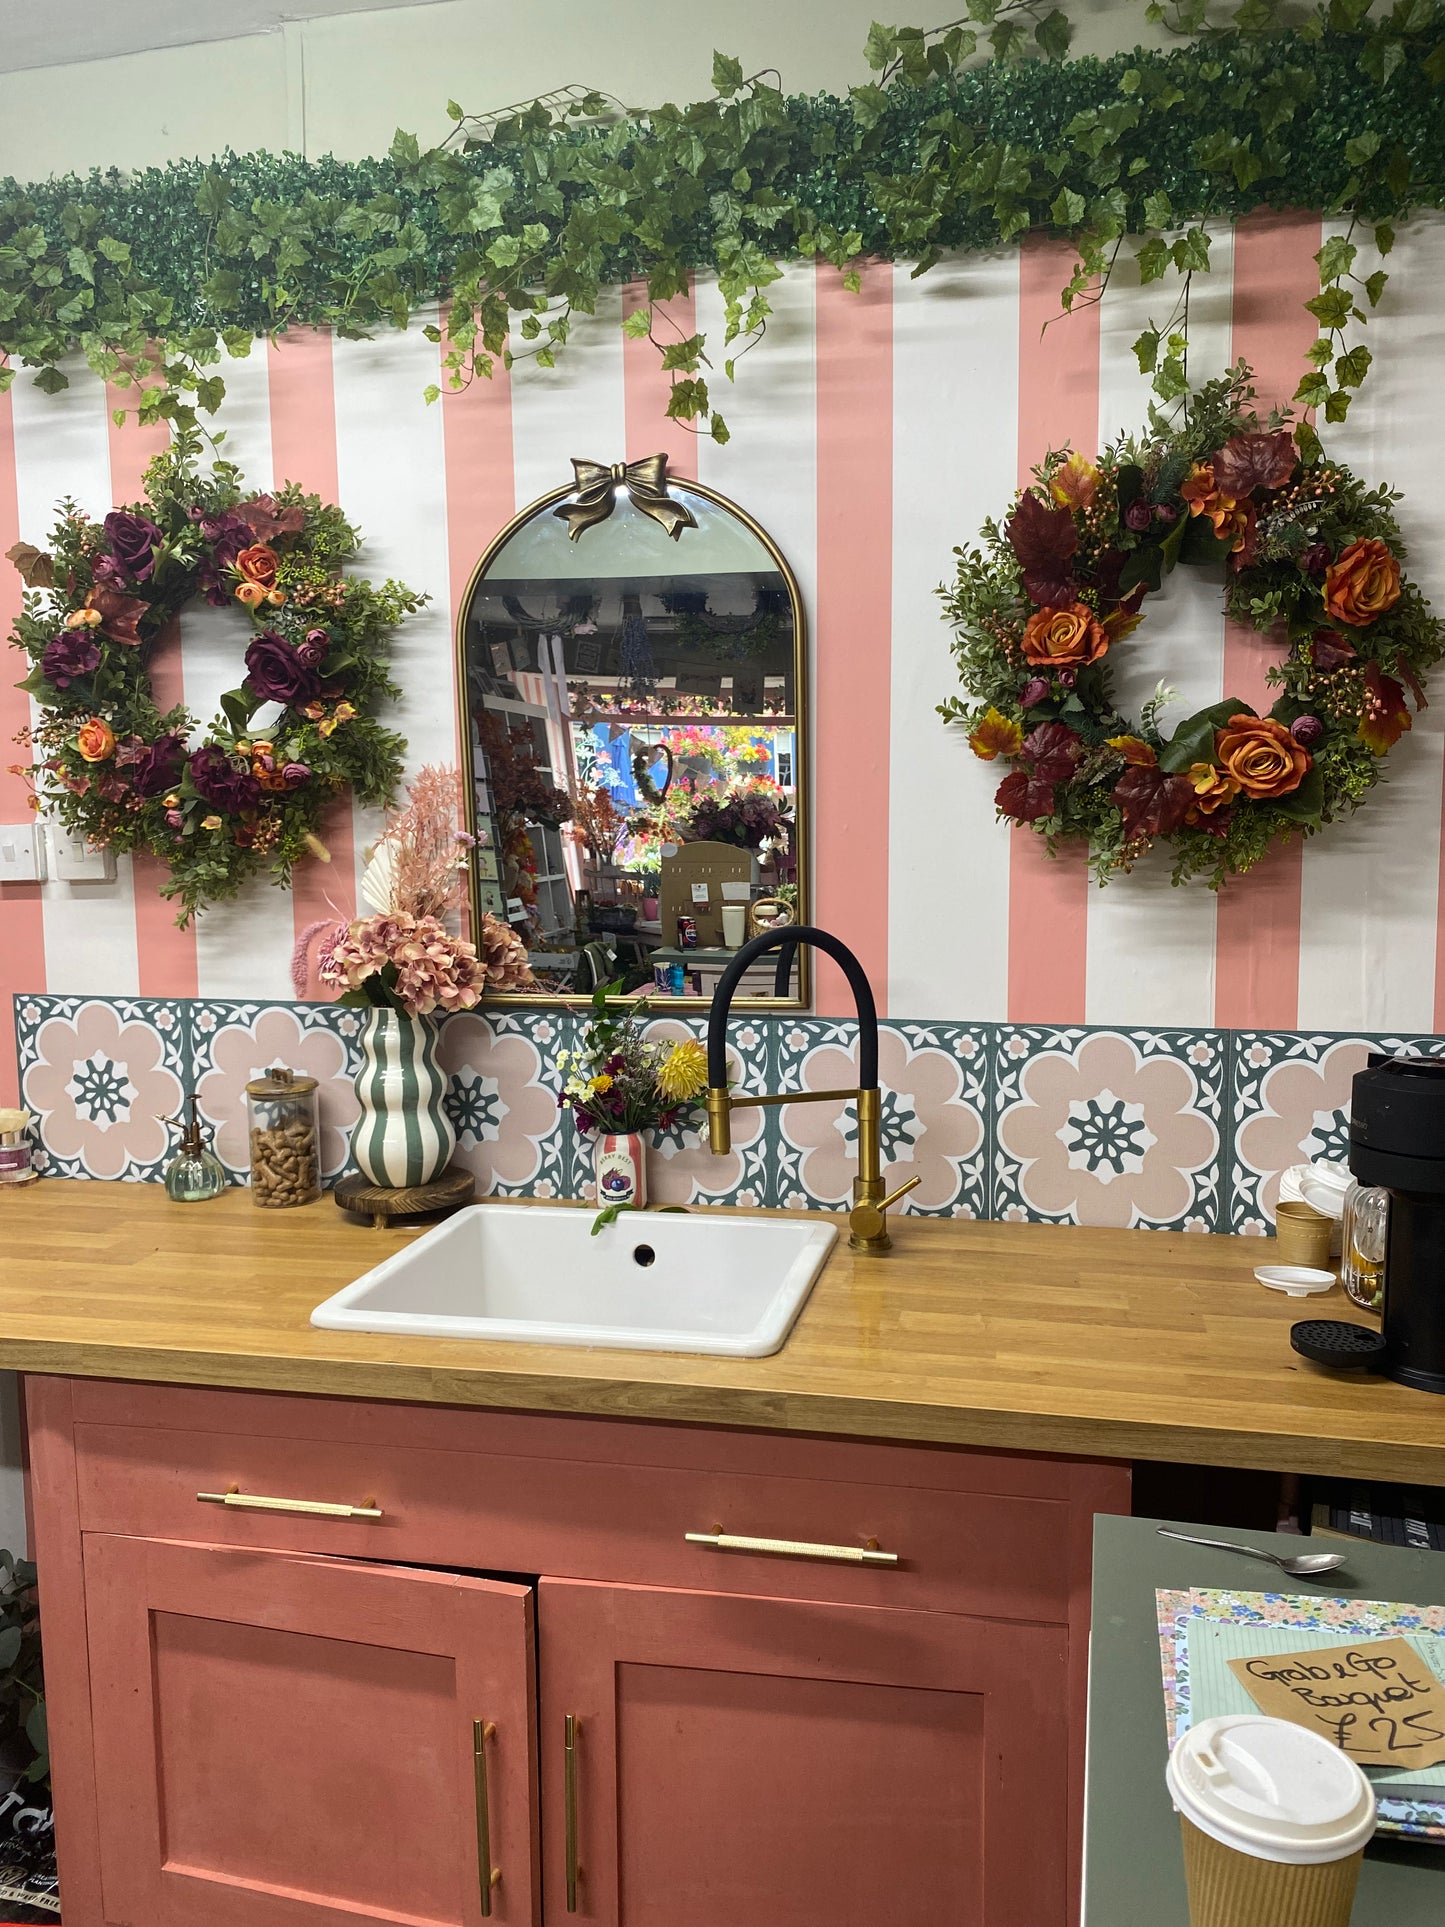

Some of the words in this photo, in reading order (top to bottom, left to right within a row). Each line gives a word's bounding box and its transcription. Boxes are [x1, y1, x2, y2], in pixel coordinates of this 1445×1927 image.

[1246, 1660, 1331, 1686] Grab
[1346, 1652, 1397, 1680] Go
[1315, 1710, 1445, 1753] £25
